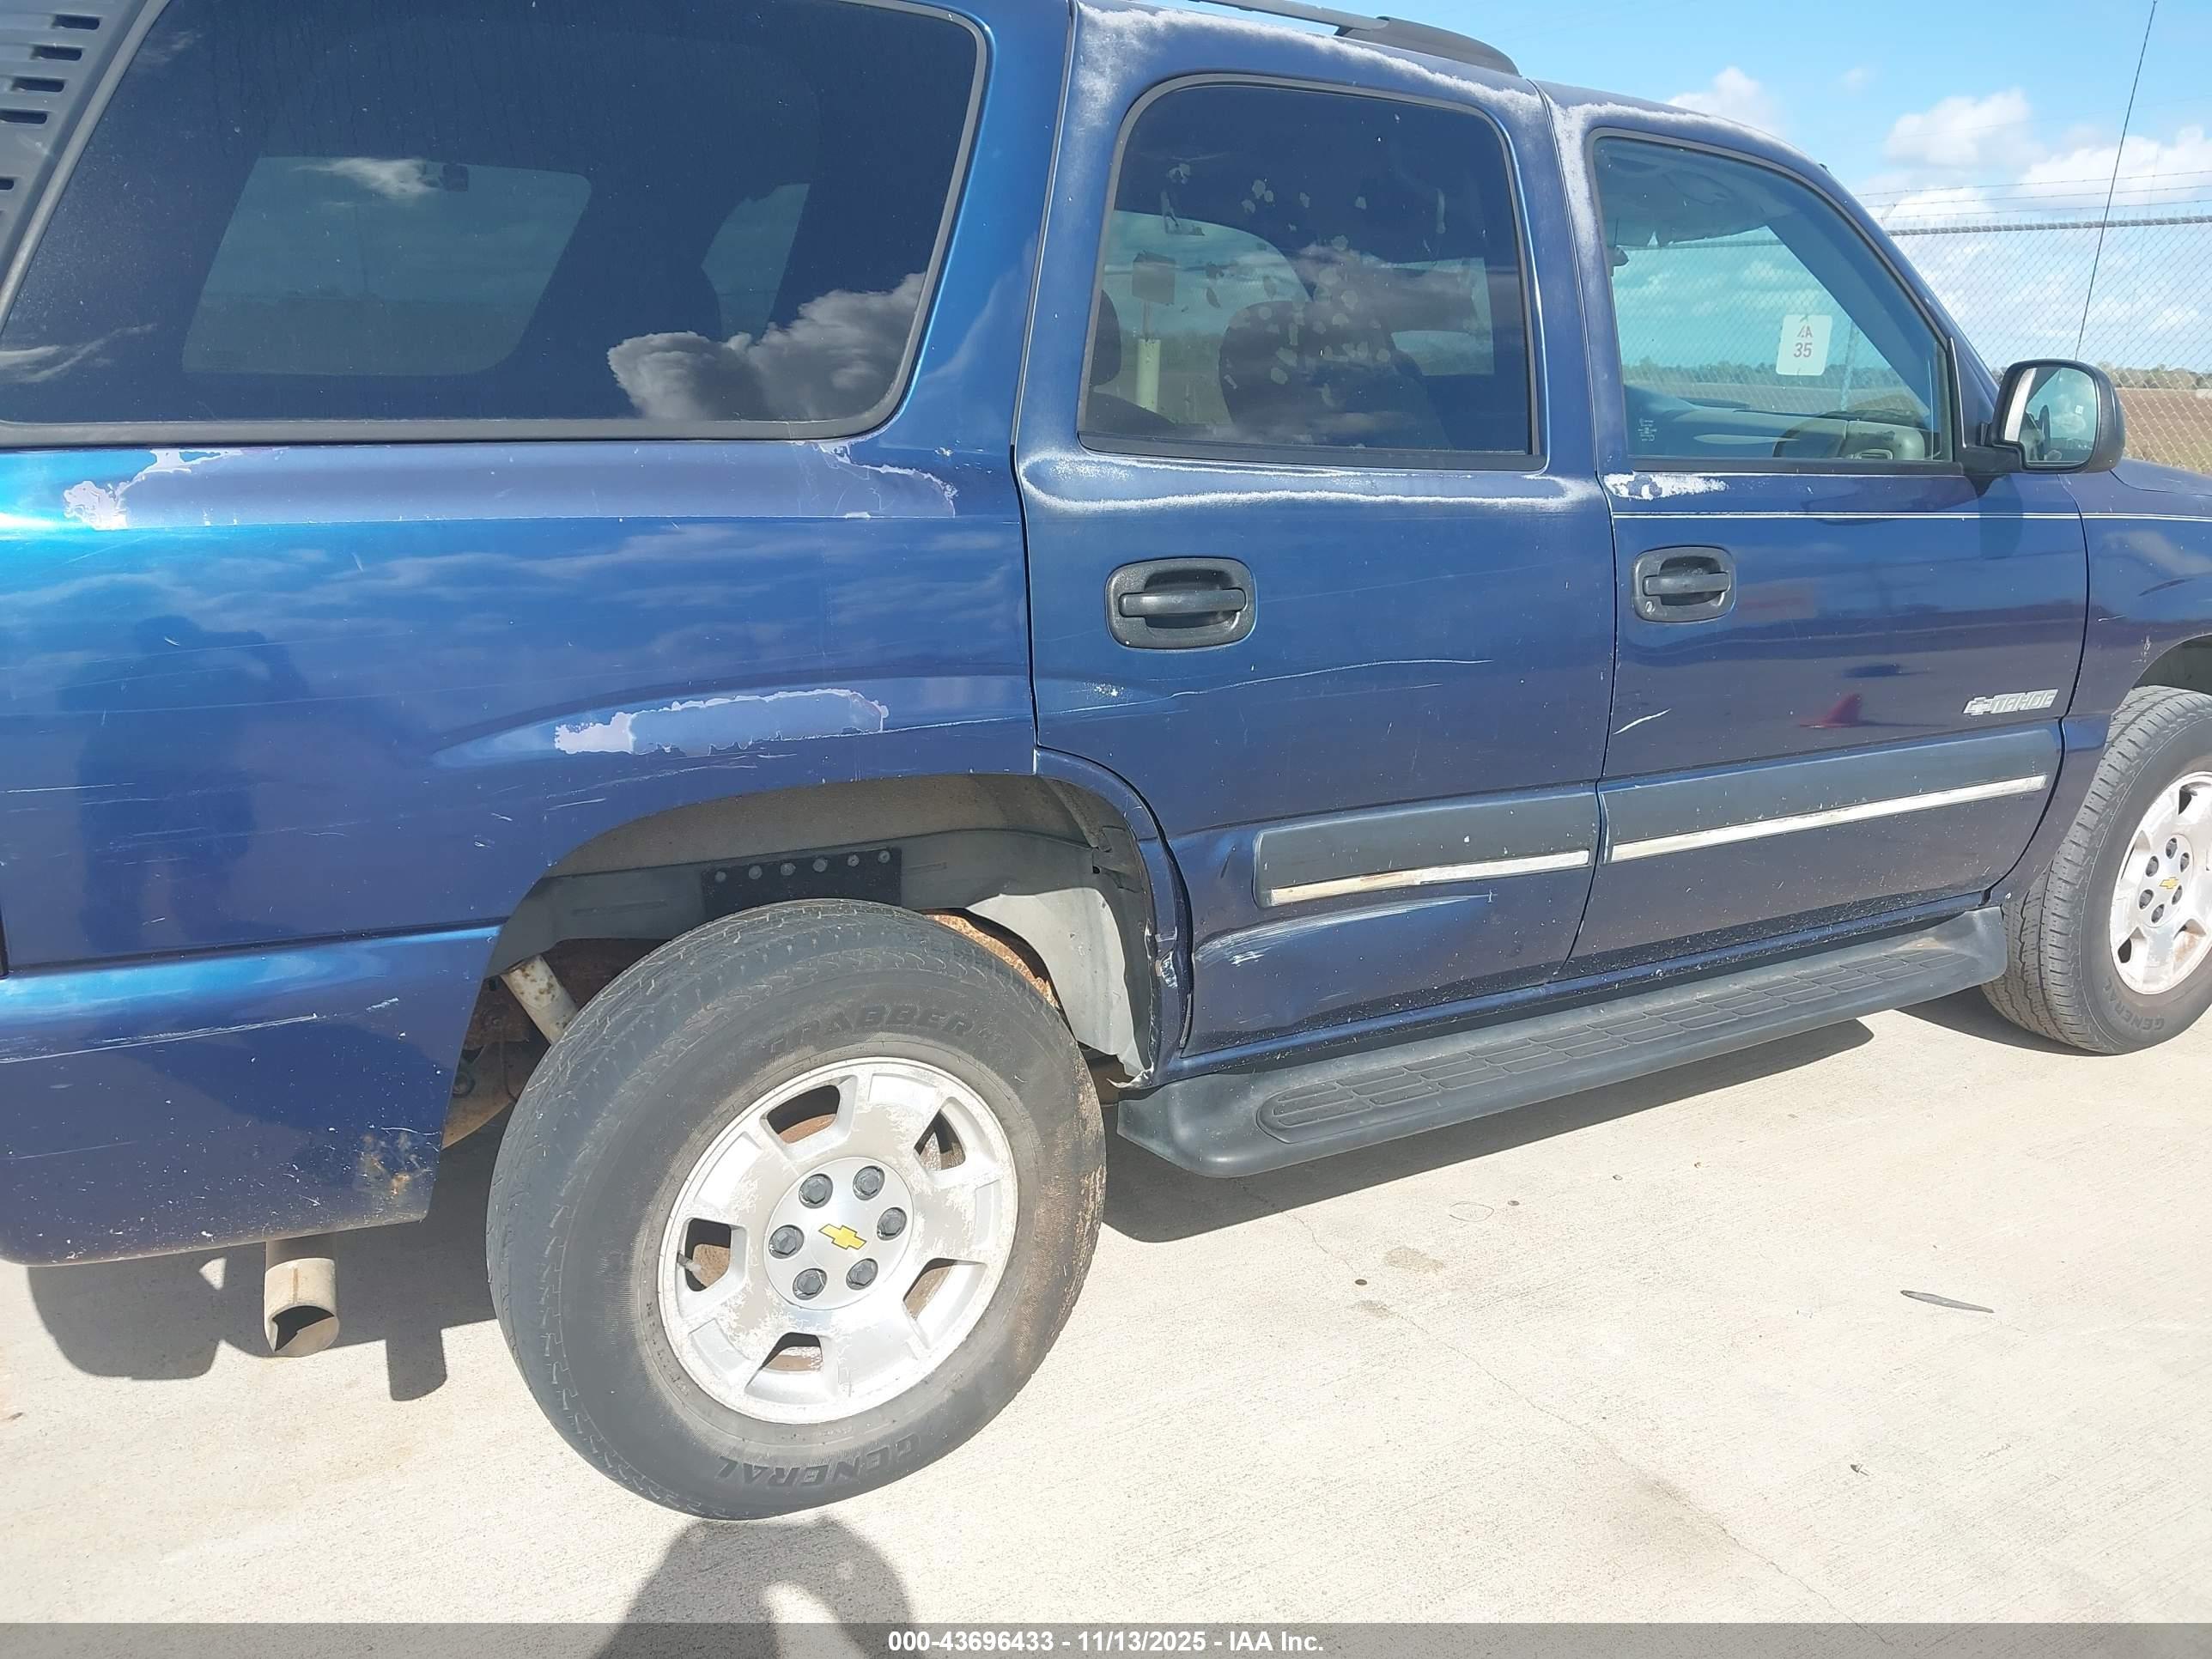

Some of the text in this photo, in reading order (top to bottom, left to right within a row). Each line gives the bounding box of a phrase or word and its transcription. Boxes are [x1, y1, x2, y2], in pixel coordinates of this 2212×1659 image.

[1793, 342, 1813, 358] 35
[1990, 689, 2059, 714] TAHOE
[2102, 975, 2165, 1031] GENERAL
[714, 1432, 921, 1487] GENERAL
